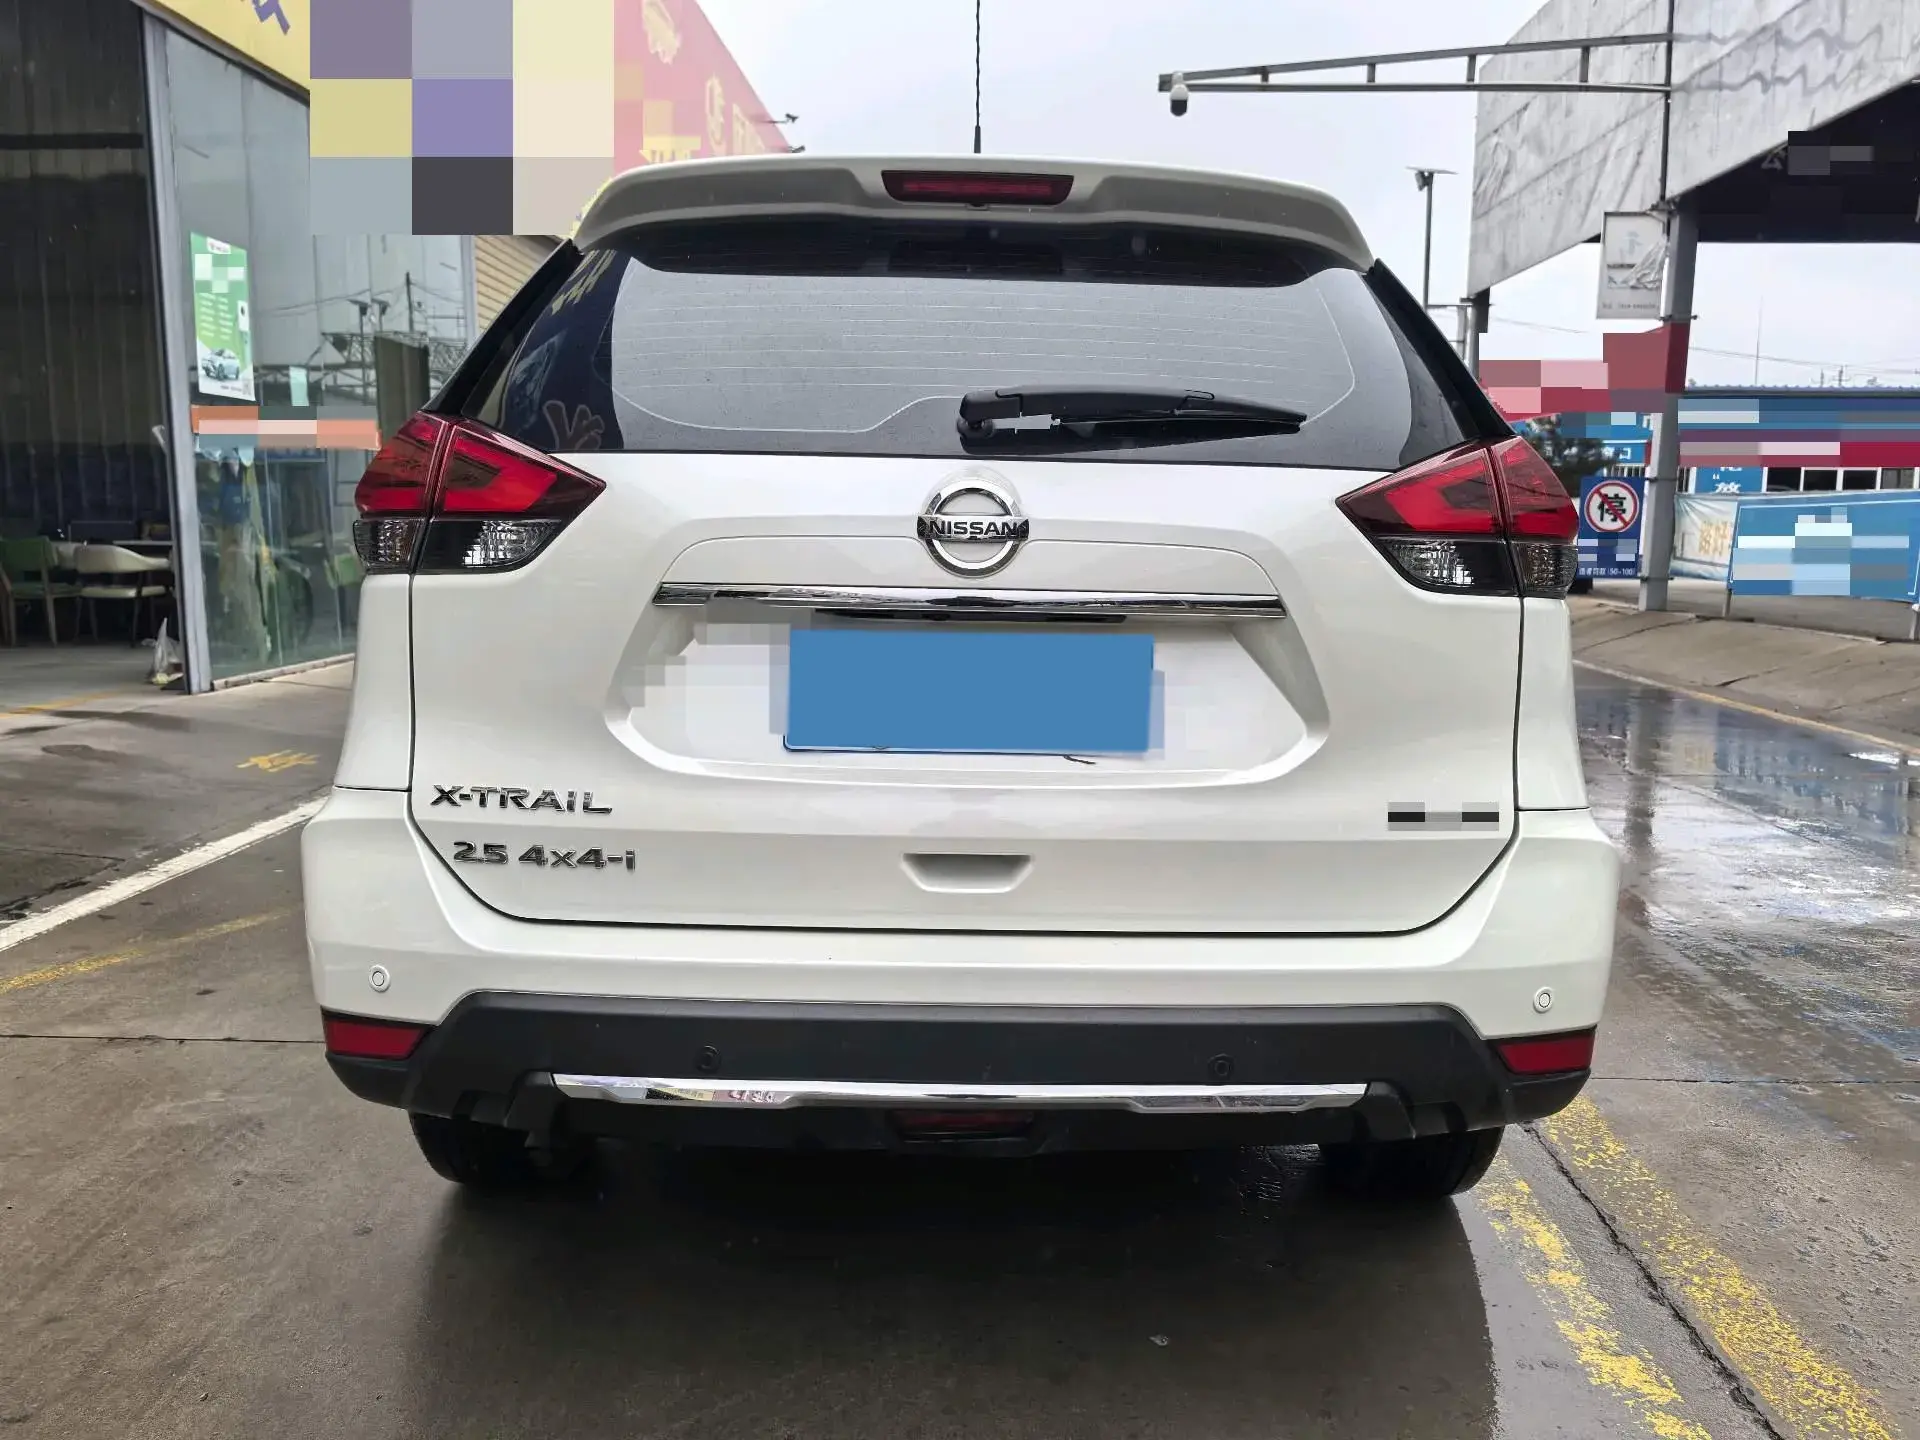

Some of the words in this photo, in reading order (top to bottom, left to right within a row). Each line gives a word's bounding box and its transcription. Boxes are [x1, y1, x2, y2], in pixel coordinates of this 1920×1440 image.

[1597, 493, 1627, 522] 停
[929, 520, 1018, 536] NISSAN
[430, 784, 613, 814] X-TRAIL
